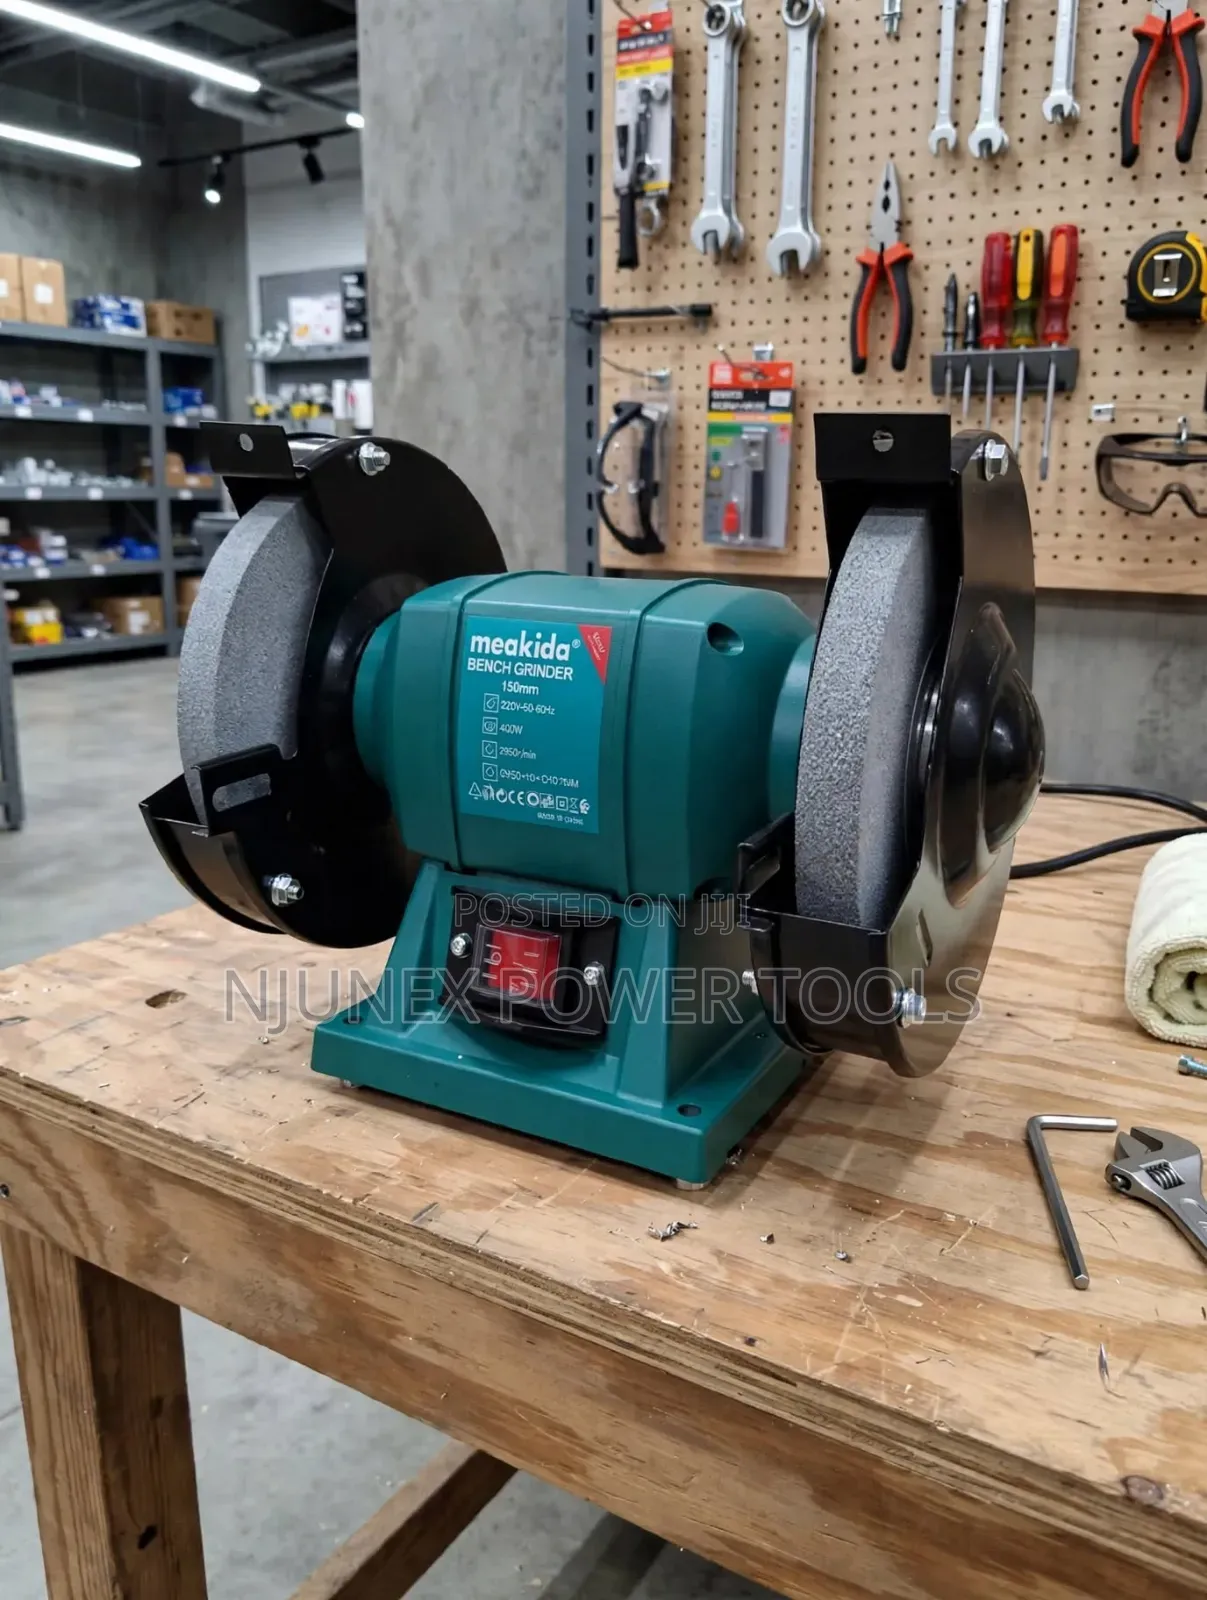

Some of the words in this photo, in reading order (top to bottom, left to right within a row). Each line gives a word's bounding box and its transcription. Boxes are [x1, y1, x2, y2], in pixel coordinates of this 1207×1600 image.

[467, 658, 511, 675] BENCH
[514, 662, 574, 681] GRINDER
[501, 680, 539, 696] 150mm
[499, 723, 523, 735] 400W
